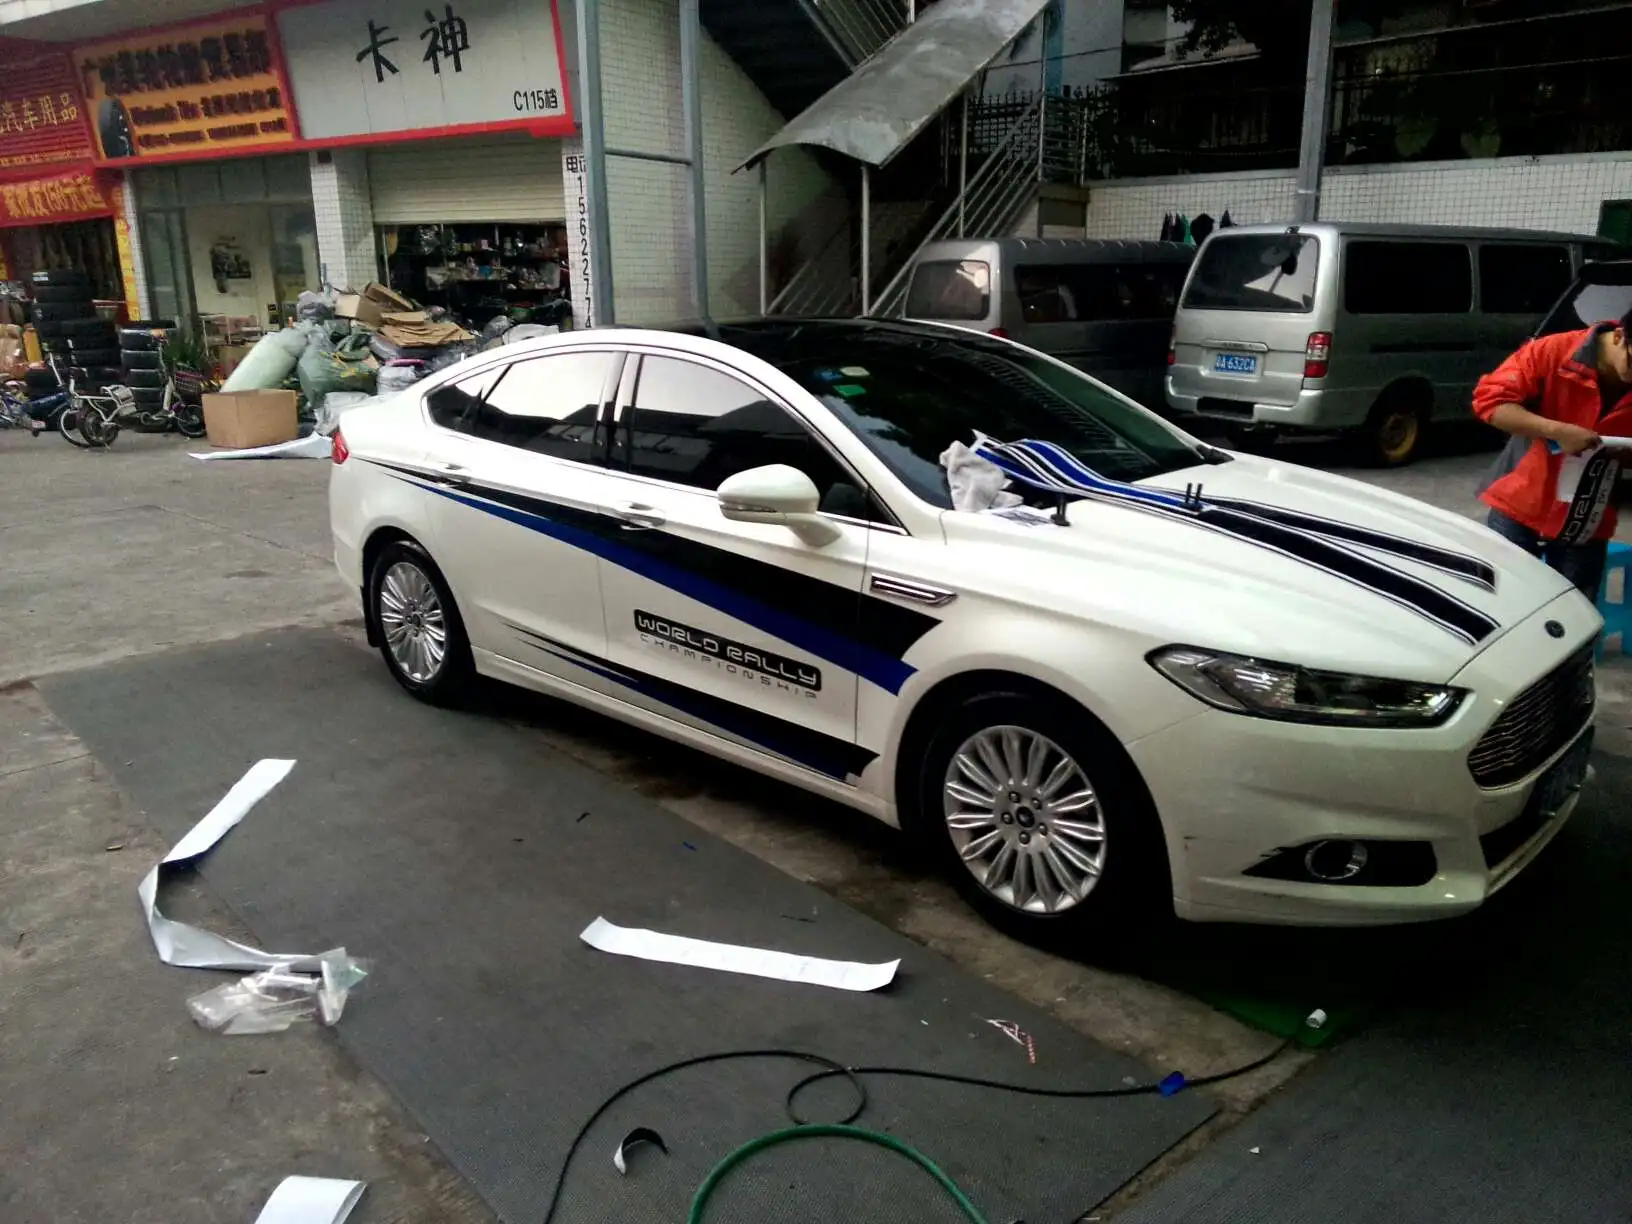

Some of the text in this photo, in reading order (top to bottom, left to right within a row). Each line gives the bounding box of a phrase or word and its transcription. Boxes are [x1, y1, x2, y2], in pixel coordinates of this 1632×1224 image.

[356, 3, 471, 83] 卡神
[0, 92, 77, 134] 汽车用品
[513, 88, 558, 112] C115档
[638, 615, 817, 686] WORLD RALLY
[639, 632, 818, 700] CHAMPIONSHIP
